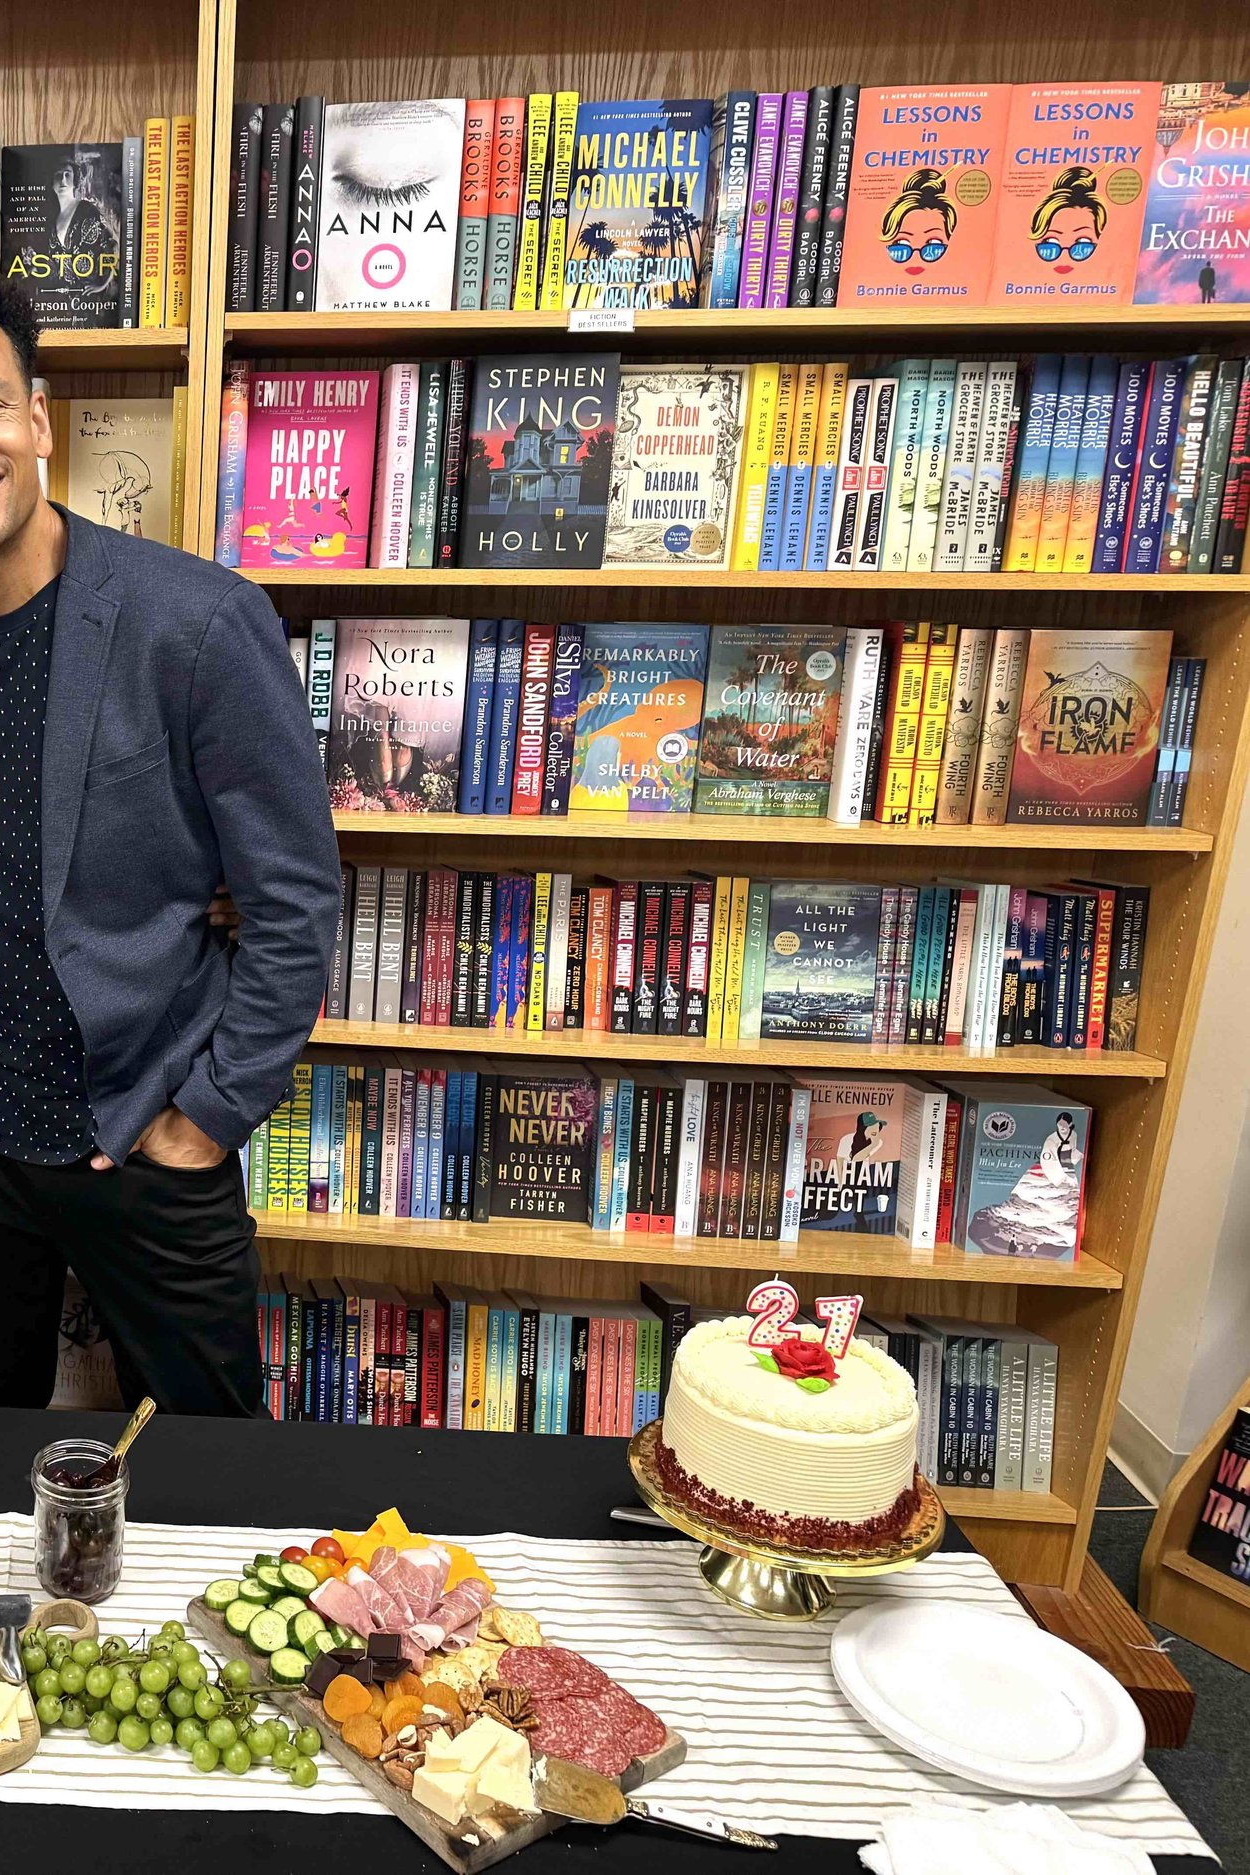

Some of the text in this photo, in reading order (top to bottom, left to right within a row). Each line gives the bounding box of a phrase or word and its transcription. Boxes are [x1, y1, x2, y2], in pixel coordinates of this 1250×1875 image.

[883, 105, 982, 124] LESSONS
[922, 129, 937, 142] in
[577, 132, 700, 170] MICHAEL
[864, 149, 990, 167] CHEMISTRY
[145, 126, 162, 277] THE LAST ACTION HEROES
[575, 173, 699, 209] CONNELLY
[462, 119, 484, 288] BROOKS HORSE
[326, 210, 447, 235] ANNA
[596, 228, 670, 238] LINCOLN LAWYER
[8, 254, 118, 279] ASTOR
[524, 241, 534, 286] SECRET
[567, 258, 692, 284] RESURRECTION
[857, 284, 967, 296] Bonnie Garmus
[334, 300, 431, 309] MATTHEW BLAKE
[488, 368, 606, 388] STEPHEN
[254, 380, 370, 407] EMILY HENRY
[425, 374, 440, 469] LISA JEWELL
[486, 396, 602, 431] KING
[657, 406, 700, 427] DEMON
[905, 390, 922, 478] NORTH WOODS
[271, 429, 346, 463] HAPPY
[636, 434, 714, 456] COPPERHEAD
[269, 467, 341, 500] PLACE
[645, 472, 698, 491] BARBARA
[632, 499, 706, 519] KINGSOLVER
[479, 531, 589, 552] HOLLY
[358, 637, 436, 672] Nora
[583, 648, 700, 662] REMARKABLY
[756, 654, 798, 676] The
[345, 673, 454, 701] Roberts
[607, 670, 672, 683] BRIGHT
[520, 632, 550, 768] JOHN SANDFORD
[586, 692, 686, 706] CREATURES
[720, 685, 825, 706] Covenant
[1048, 696, 1134, 724] IRON
[340, 714, 452, 734] Inheritance
[759, 715, 783, 739] of
[1039, 731, 1136, 755] FLAME
[736, 746, 799, 769] Water
[598, 764, 662, 778] SHELBY
[588, 786, 670, 799] VAN PELT
[709, 789, 816, 803] Abraham Verghese
[1017, 806, 1138, 818] REBECCA YARROS
[795, 905, 855, 916] ALL THE
[804, 922, 847, 933] LIGHT
[355, 896, 376, 982] HELL BENT
[814, 940, 835, 950] WE
[793, 958, 853, 968] CANNOT
[1091, 899, 1112, 1024] SUPERMARKET
[809, 975, 834, 984] SEE
[768, 1019, 868, 1031] ANTHONY DOERR
[499, 1088, 574, 1116] NEVER
[836, 1091, 894, 1106] KENNEDY
[510, 1118, 586, 1145] NEVER
[510, 1153, 571, 1165] COLLEEN
[980, 1148, 1052, 1160] PACHINKO
[498, 1164, 581, 1183] HOOVER
[519, 1190, 557, 1199] TARRYN
[510, 1199, 565, 1213] FISHER
[471, 1364, 481, 1399] HONEY
